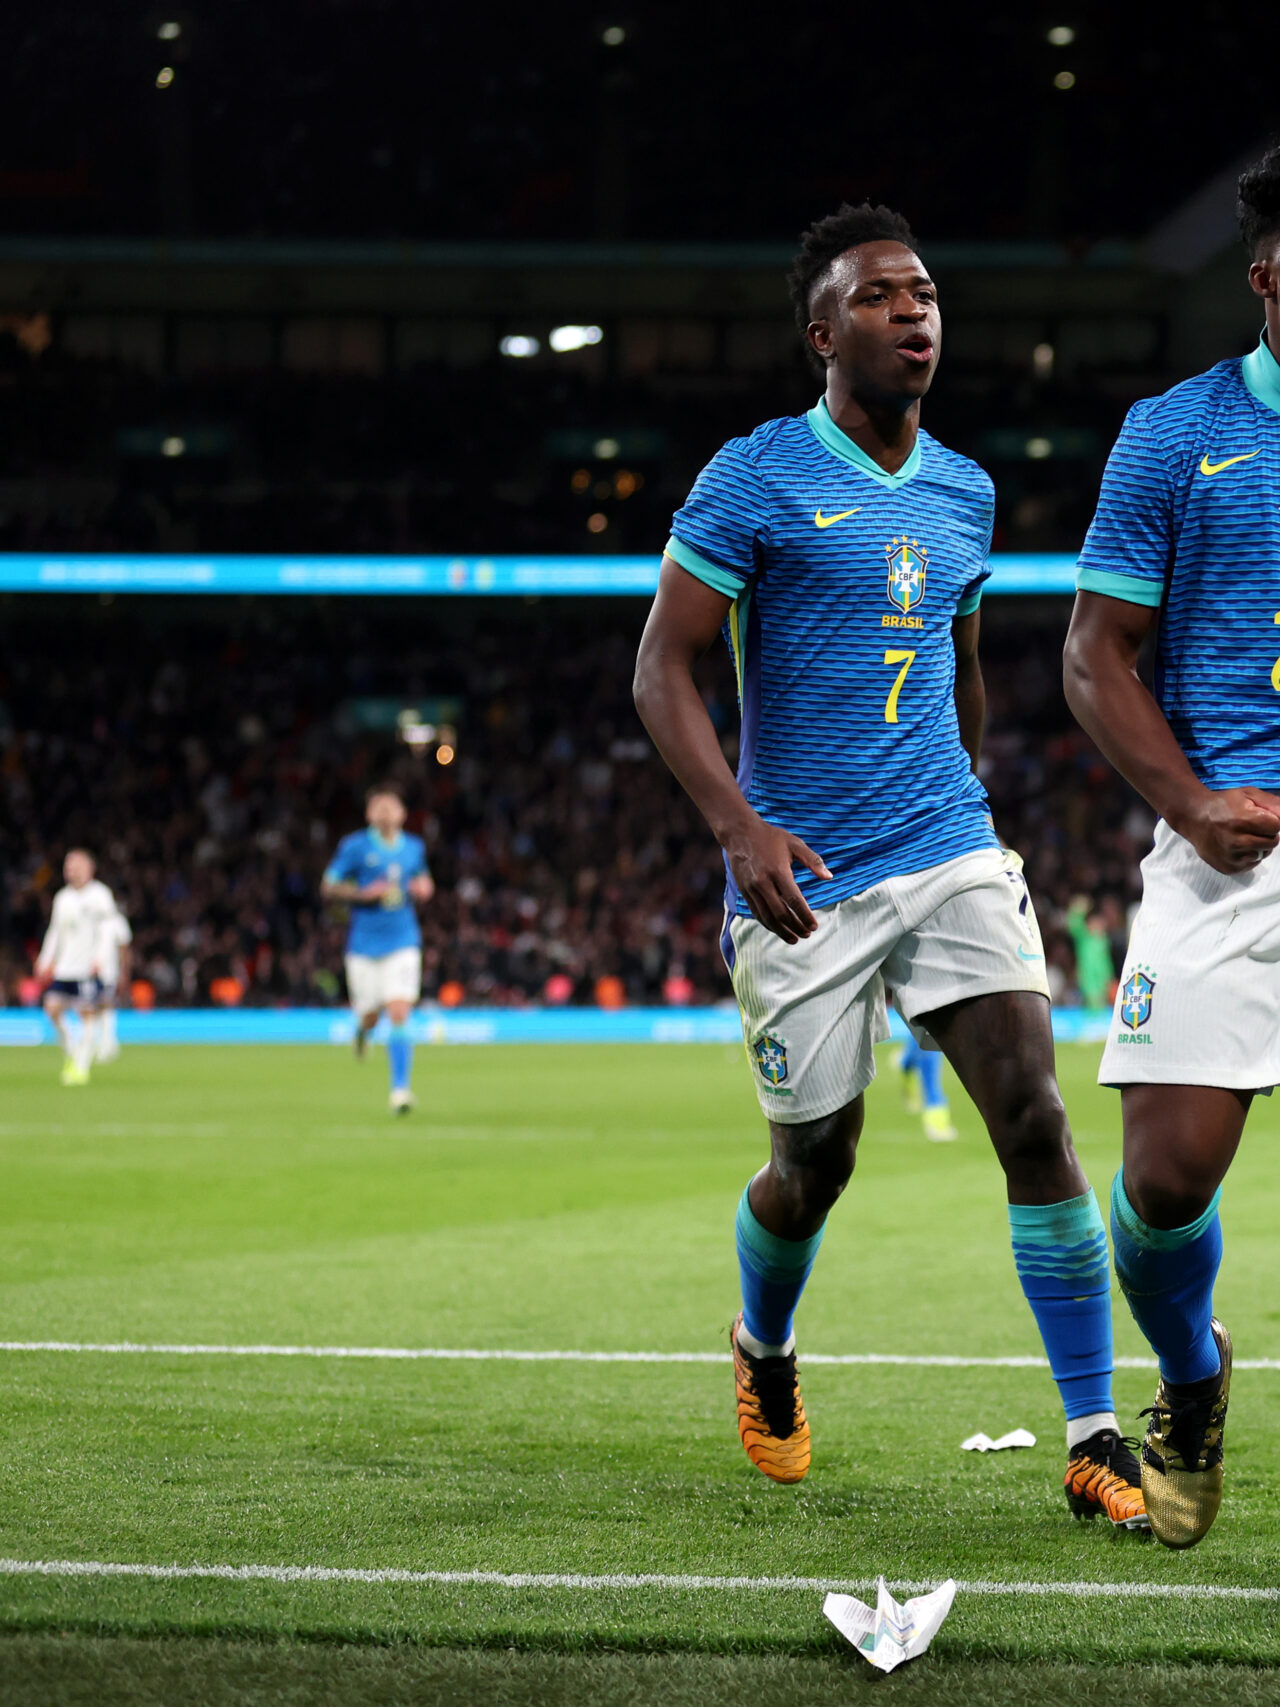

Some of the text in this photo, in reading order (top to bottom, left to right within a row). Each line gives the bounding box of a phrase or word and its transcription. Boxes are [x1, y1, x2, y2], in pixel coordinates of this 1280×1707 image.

[898, 572, 915, 581] CBF
[881, 615, 924, 629] BRASIL
[883, 649, 917, 723] 7
[1129, 995, 1143, 1004] CBF
[1117, 1033, 1153, 1045] BRASIL
